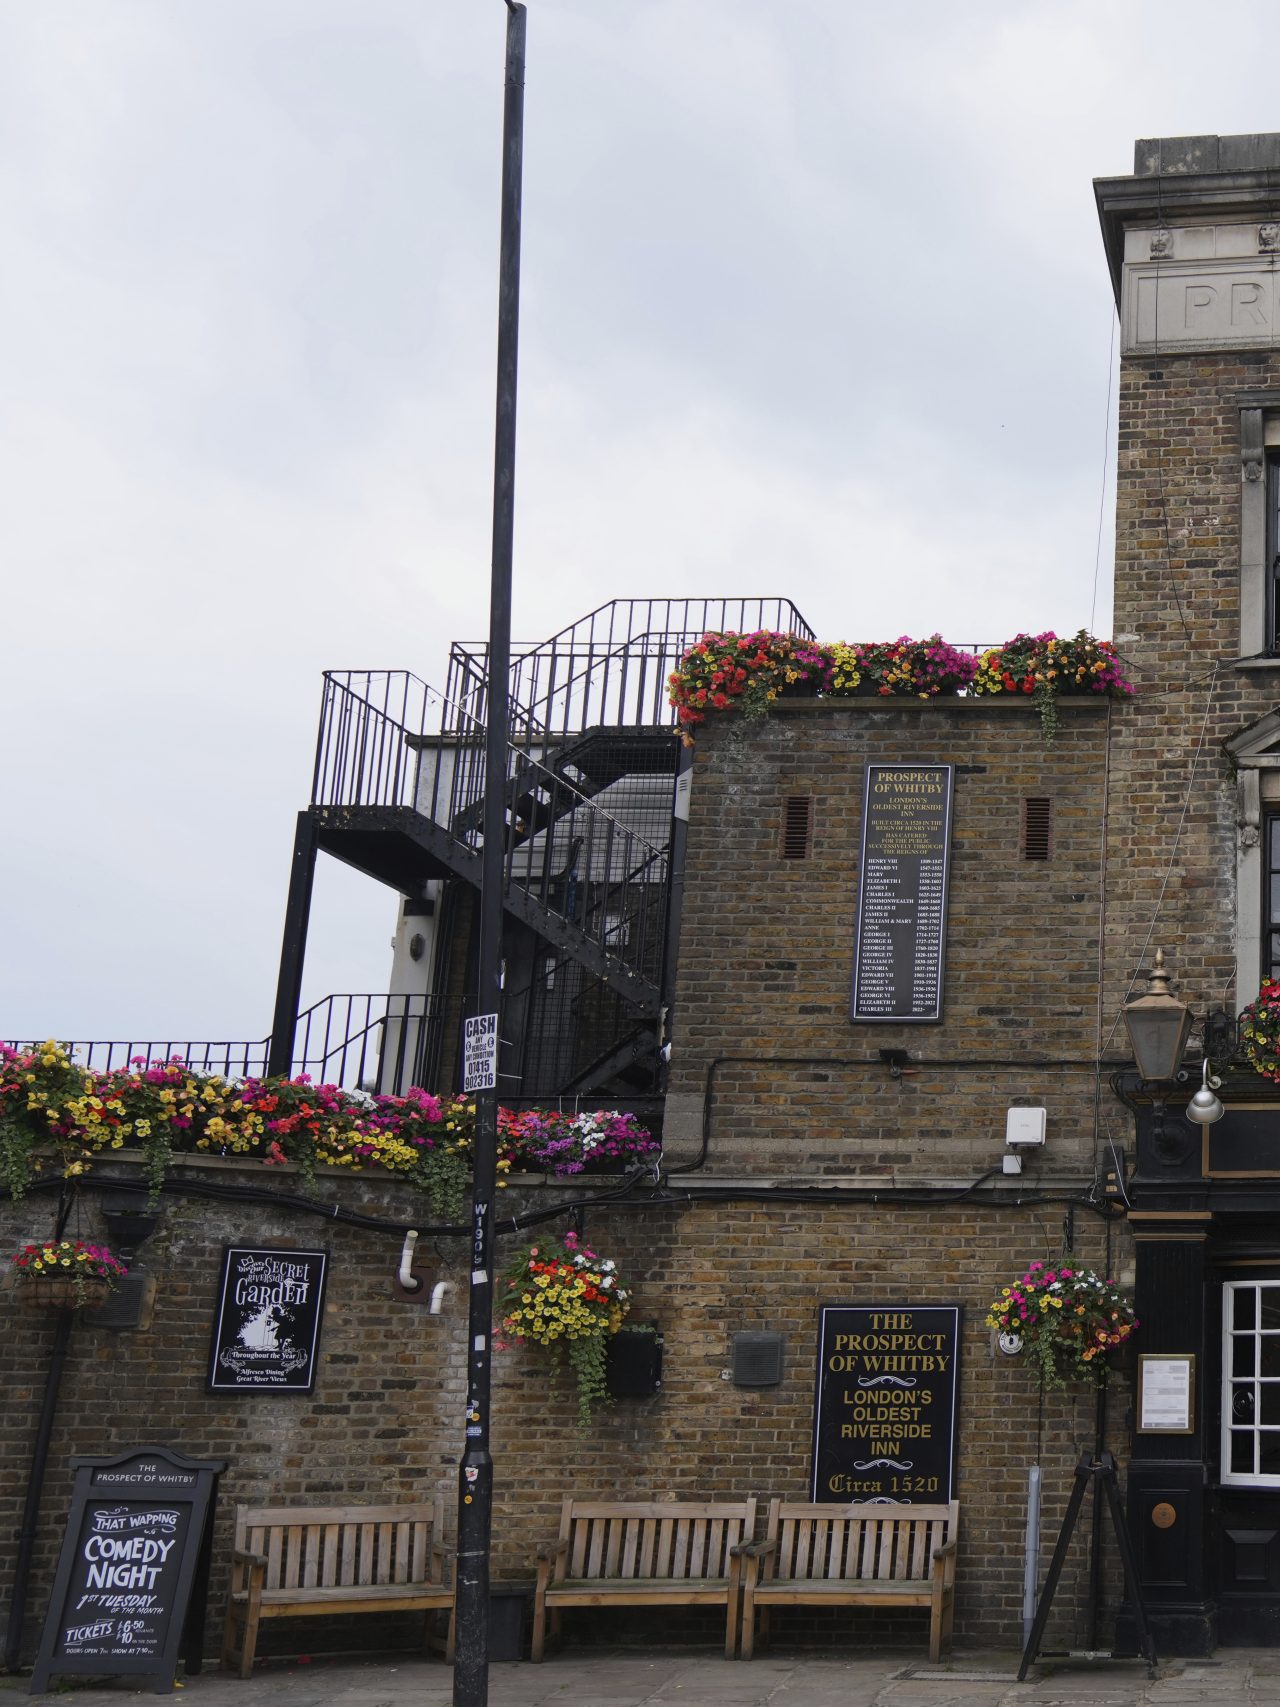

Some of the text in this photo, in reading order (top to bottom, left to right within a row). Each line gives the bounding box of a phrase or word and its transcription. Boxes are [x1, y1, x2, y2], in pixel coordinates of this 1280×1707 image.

[878, 773, 941, 781] PROSPECT
[874, 784, 943, 793] OF WHITBY
[467, 1016, 495, 1038] CASH
[466, 1073, 493, 1089] 902316
[869, 1314, 912, 1330] THE
[835, 1335, 946, 1350] PROSPECT
[829, 1356, 950, 1372] OF WHITBY
[844, 1390, 932, 1405] LONDON'S
[853, 1407, 921, 1421] OLDEST
[841, 1424, 931, 1438] RIVERSIDE
[871, 1441, 899, 1455] INN
[97, 1473, 142, 1482] PROSPECT
[158, 1475, 194, 1483] WHITBY
[829, 1473, 939, 1493] Circa 1520
[96, 1514, 177, 1530] THAT WAPPING
[85, 1535, 175, 1562] COMEDY
[86, 1562, 162, 1589] NIGHT
[98, 1595, 157, 1607] TUESDAY
[66, 1622, 113, 1642] TICKETS
